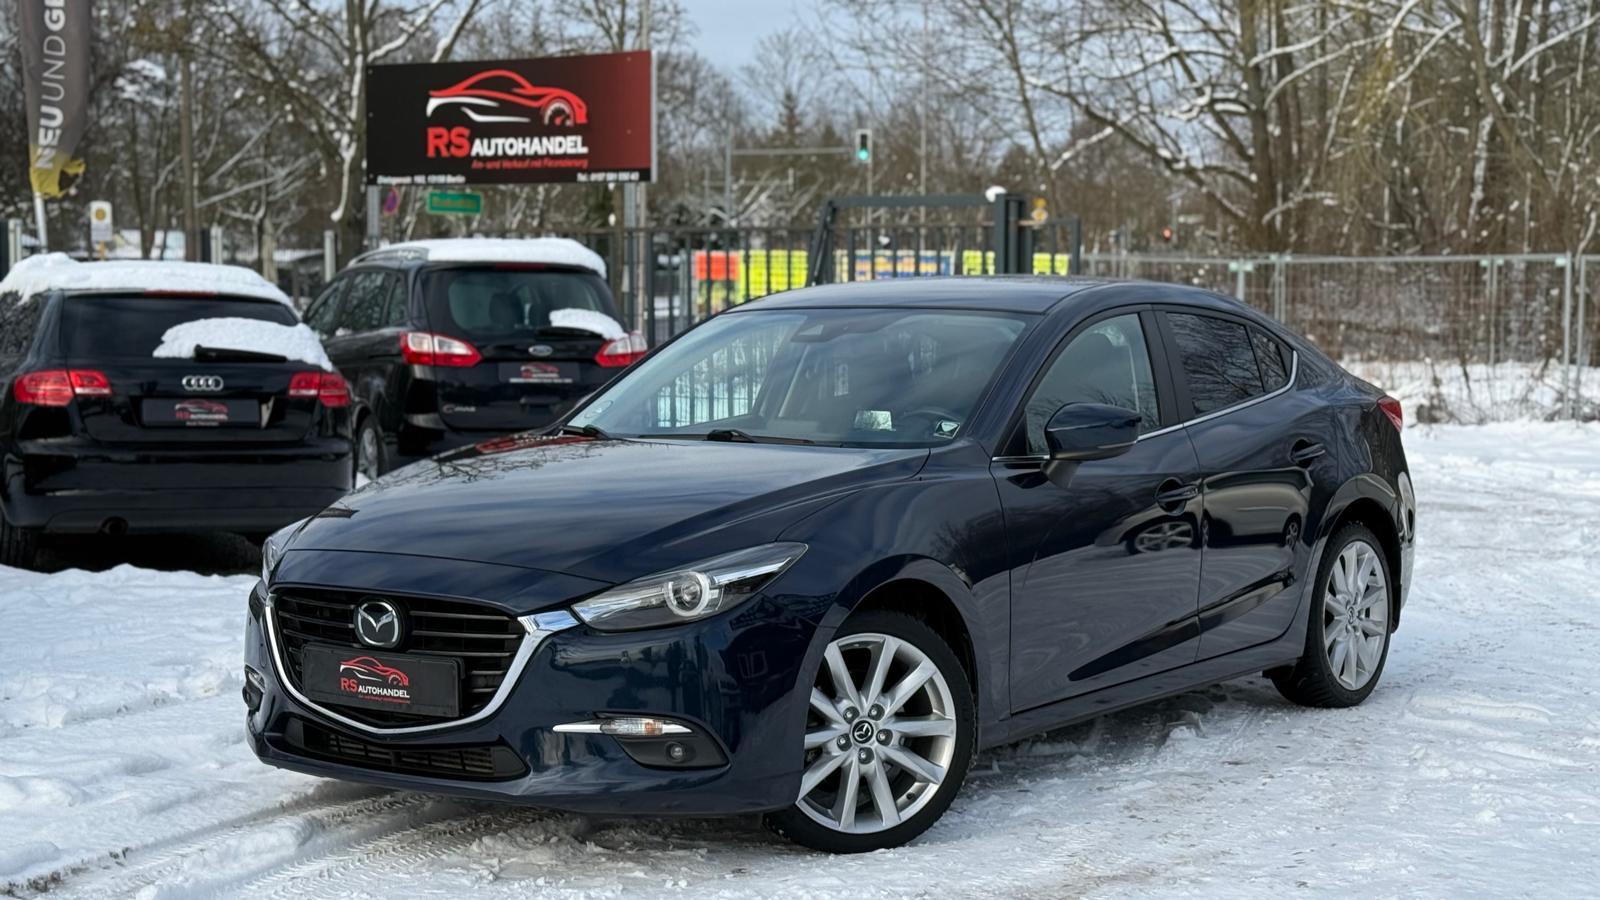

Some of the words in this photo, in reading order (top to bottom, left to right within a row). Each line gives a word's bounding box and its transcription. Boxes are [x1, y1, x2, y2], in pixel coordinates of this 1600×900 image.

[426, 126, 471, 158] RS
[471, 135, 588, 157] AUTOHANDEL
[340, 677, 358, 693] RS
[358, 685, 410, 698] AUTOHANDEL
